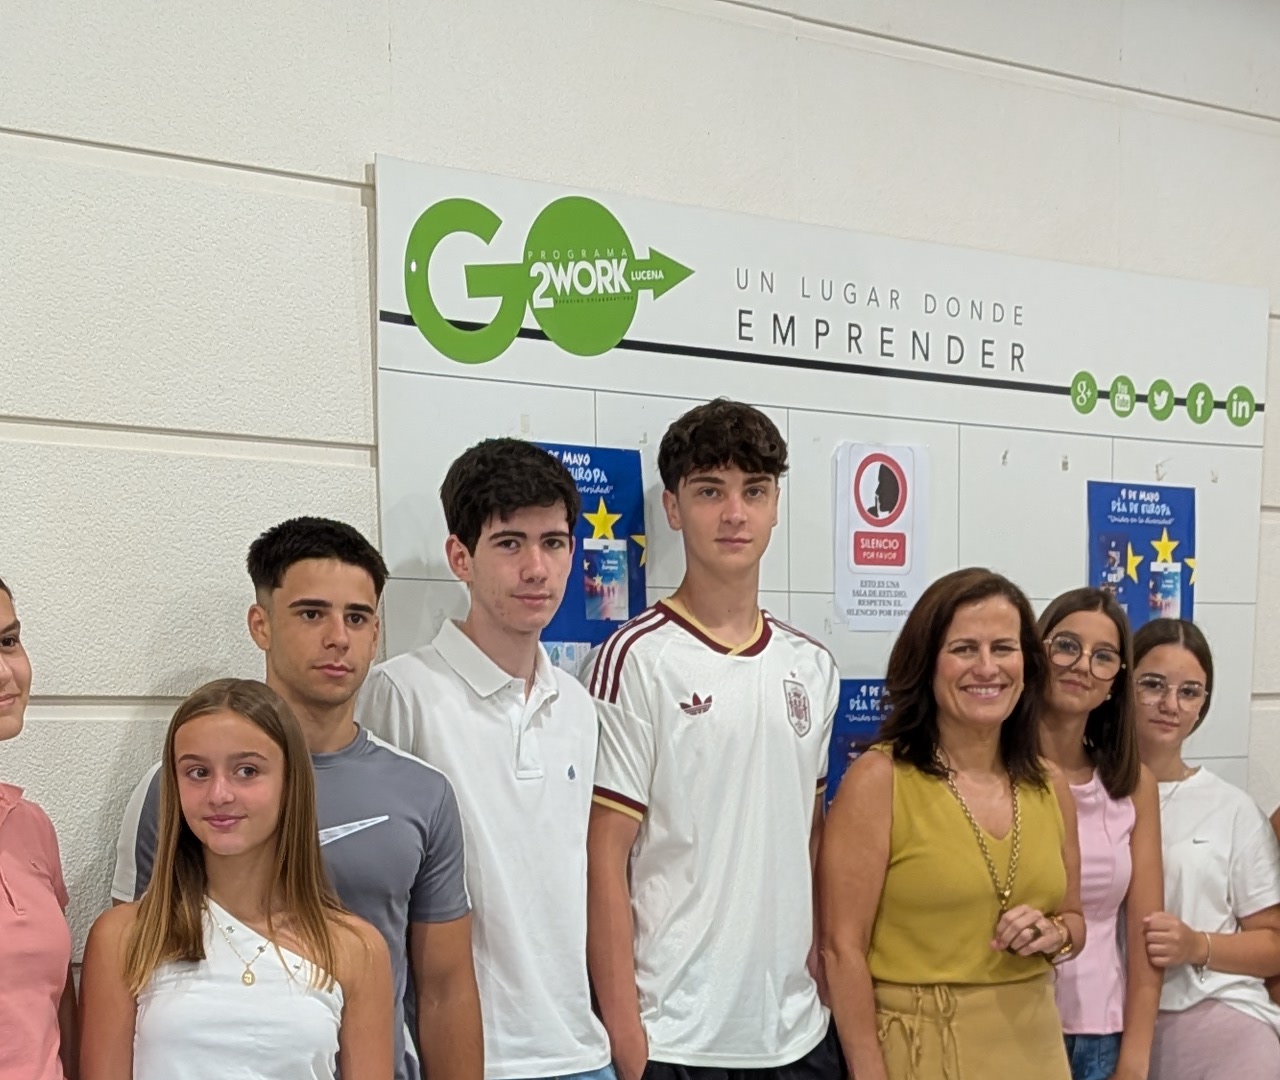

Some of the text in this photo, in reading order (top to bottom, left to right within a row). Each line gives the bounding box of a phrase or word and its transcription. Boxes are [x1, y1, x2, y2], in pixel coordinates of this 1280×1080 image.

[528, 248, 628, 260] PROGRAMA
[631, 270, 664, 281] LUCENA
[529, 258, 632, 309] 2WORK
[736, 267, 1024, 326] UN LUGAR DONDE
[737, 309, 1025, 373] EMPRENDER
[562, 451, 590, 466] MAYO
[569, 467, 608, 483] UROPA
[1128, 490, 1137, 500] DE
[1139, 490, 1160, 503] MAYO
[1129, 502, 1139, 514] DE
[1141, 503, 1171, 516] EUROPA
[860, 538, 899, 550] SILENCIO
[863, 551, 897, 560] POR FAVOR
[860, 580, 876, 588] ESTO
[877, 580, 885, 588] ES
[852, 589, 867, 597] SALA
[860, 685, 867, 697] 9
[869, 686, 880, 697] DE
